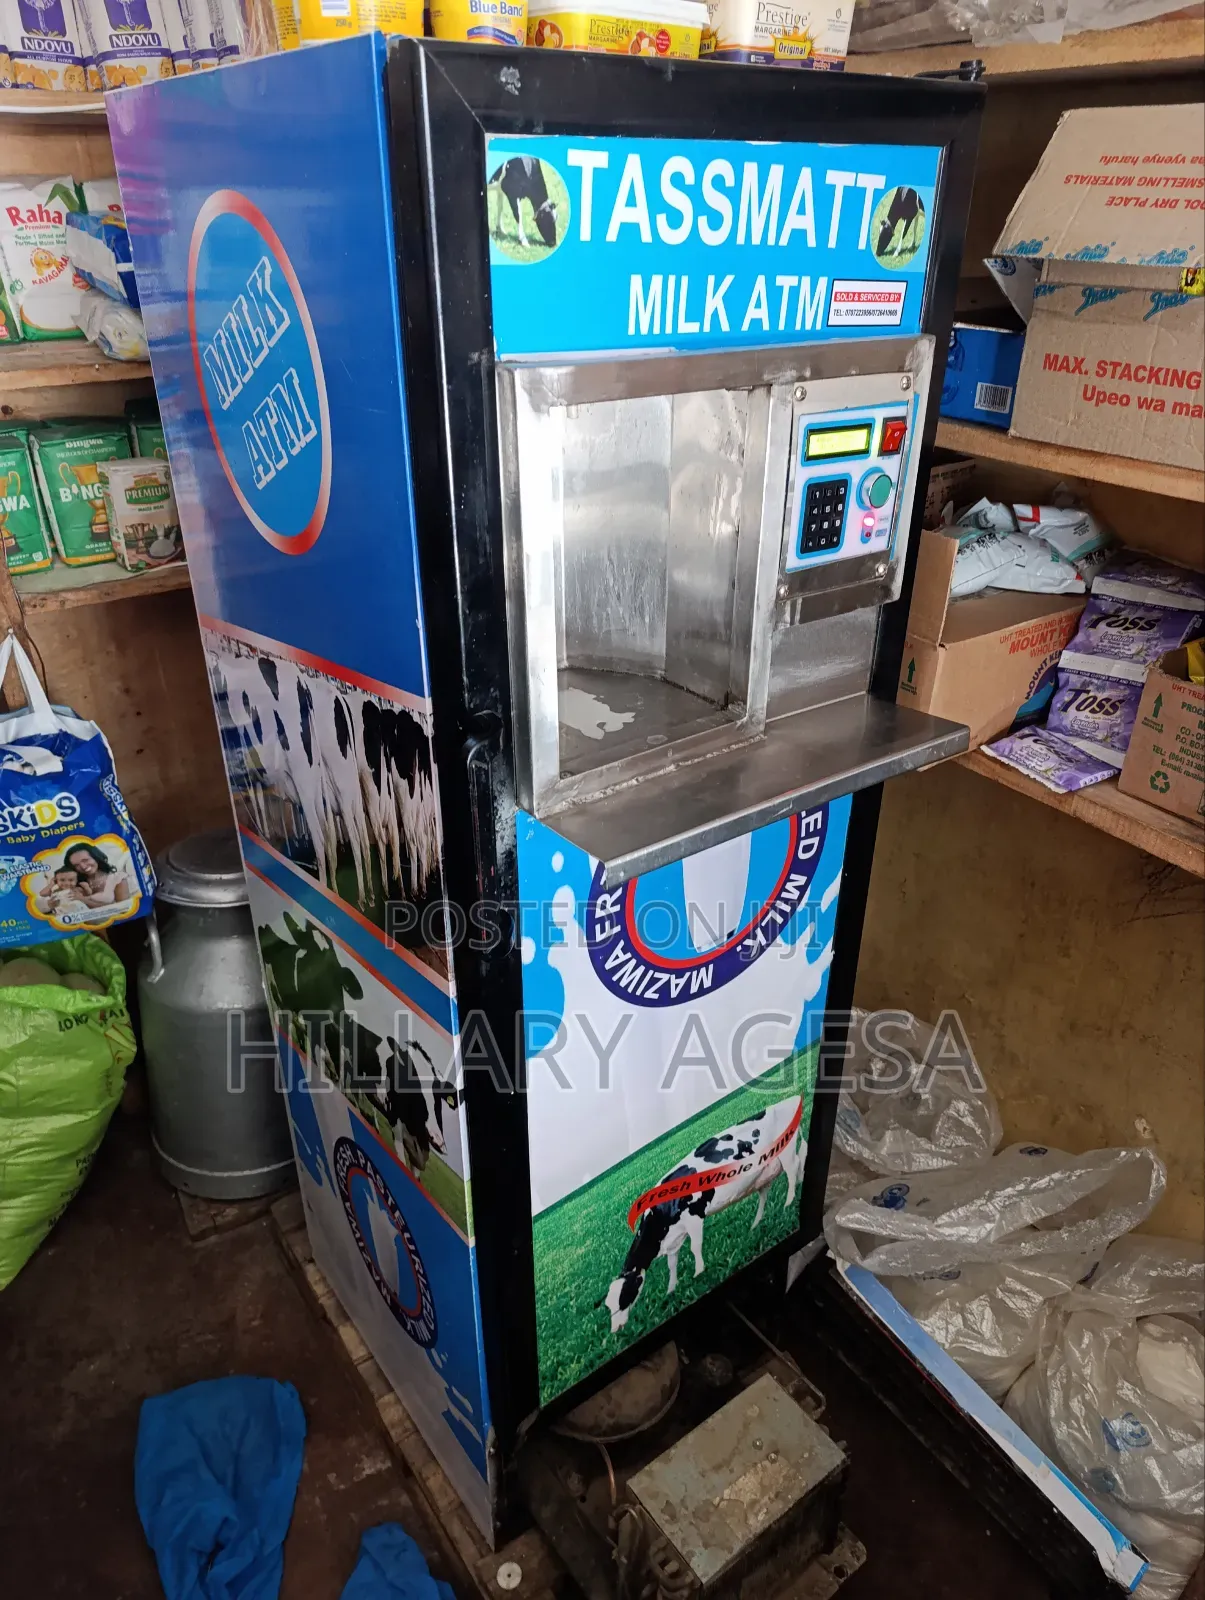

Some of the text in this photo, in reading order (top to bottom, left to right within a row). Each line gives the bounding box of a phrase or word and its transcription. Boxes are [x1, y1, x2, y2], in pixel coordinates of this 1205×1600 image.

[470, 0, 523, 17] Blue Band
[756, 1, 808, 32] Prestige
[590, 19, 630, 39] Prestige
[755, 25, 792, 36] MARGARINE
[24, 38, 72, 54] NDOVU
[112, 34, 159, 47] NDOVU
[588, 35, 618, 44] MARGARINE
[778, 42, 807, 55] Original
[1099, 154, 1139, 165] harufu
[1142, 153, 1187, 166] vyenye
[1063, 174, 1205, 189] SMELLING MATERIALS
[567, 149, 886, 250] TASSMATT
[1105, 195, 1147, 208] PLACE
[1149, 197, 1180, 209] DRY
[5, 204, 64, 227] Raha
[627, 274, 828, 335] MILK ATM
[836, 292, 853, 301] SOLD
[853, 293, 859, 301] &
[860, 293, 889, 302] SERVICED
[203, 256, 291, 411] MILK
[1042, 353, 1202, 390] MAX. STACKING
[1082, 384, 1131, 408] Upeo
[1137, 396, 1165, 413] wa
[241, 367, 318, 490] ATM
[125, 487, 169, 499] PREMIUM
[1000, 633, 1014, 644] UHT
[1015, 623, 1043, 639] TREATED
[1008, 628, 1058, 655] MOUNT
[1030, 640, 1057, 658] WHOLE
[1171, 683, 1187, 694] UHT
[1152, 744, 1167, 756] TEL:
[1179, 746, 1205, 762] INDUST
[6, 820, 86, 845] Baby Diapers
[797, 806, 823, 861] ED
[0, 864, 51, 881] WAISTBAND
[10, 859, 43, 872] ELASTIC
[604, 939, 714, 999] MAZIWA
[636, 1129, 796, 1212] Fresh Whole Milk
[356, 1149, 435, 1331] PASTEURIZED
[345, 1201, 392, 1305] MAZIWA
